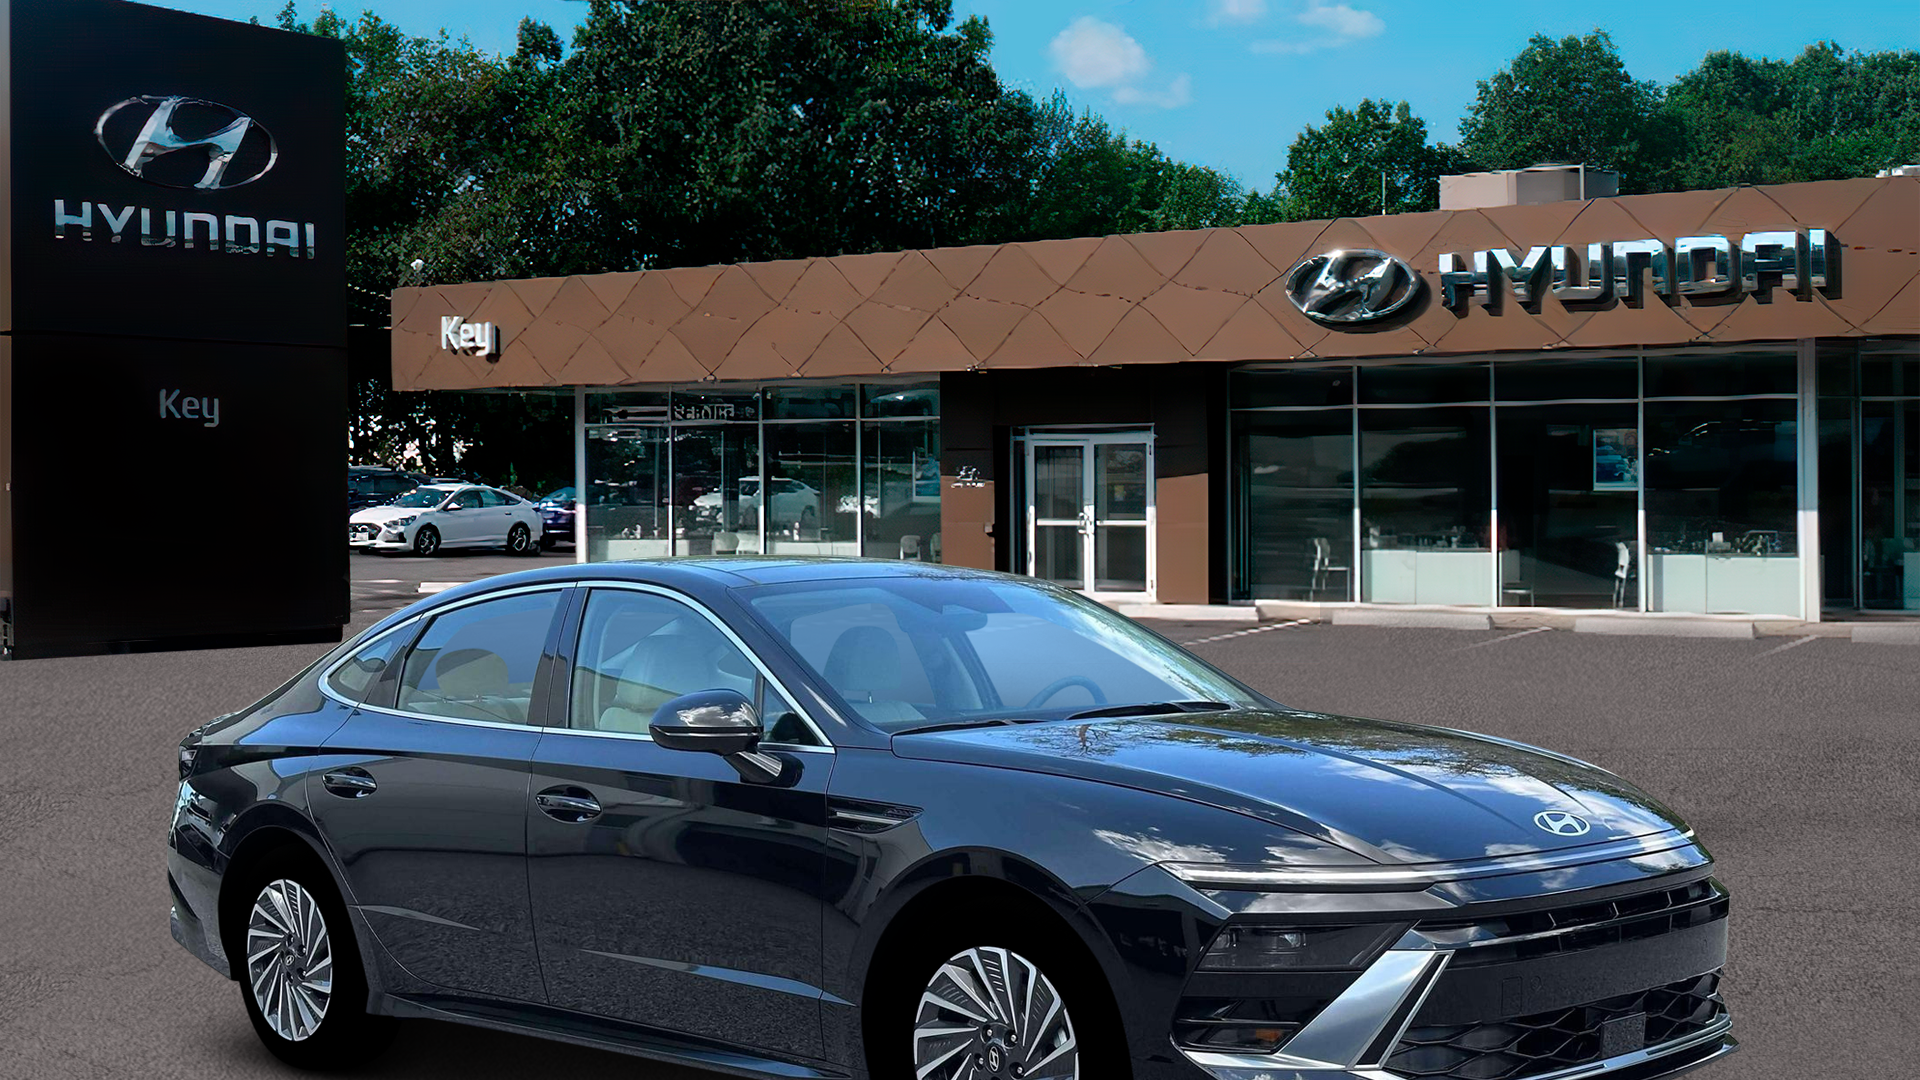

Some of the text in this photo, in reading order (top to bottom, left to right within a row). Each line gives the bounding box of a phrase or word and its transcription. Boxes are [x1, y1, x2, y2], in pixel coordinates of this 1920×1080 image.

[55, 199, 315, 259] HYUNDAI
[1438, 228, 1830, 307] HYUNDAI
[441, 315, 493, 357] Key
[159, 388, 219, 427] Key
